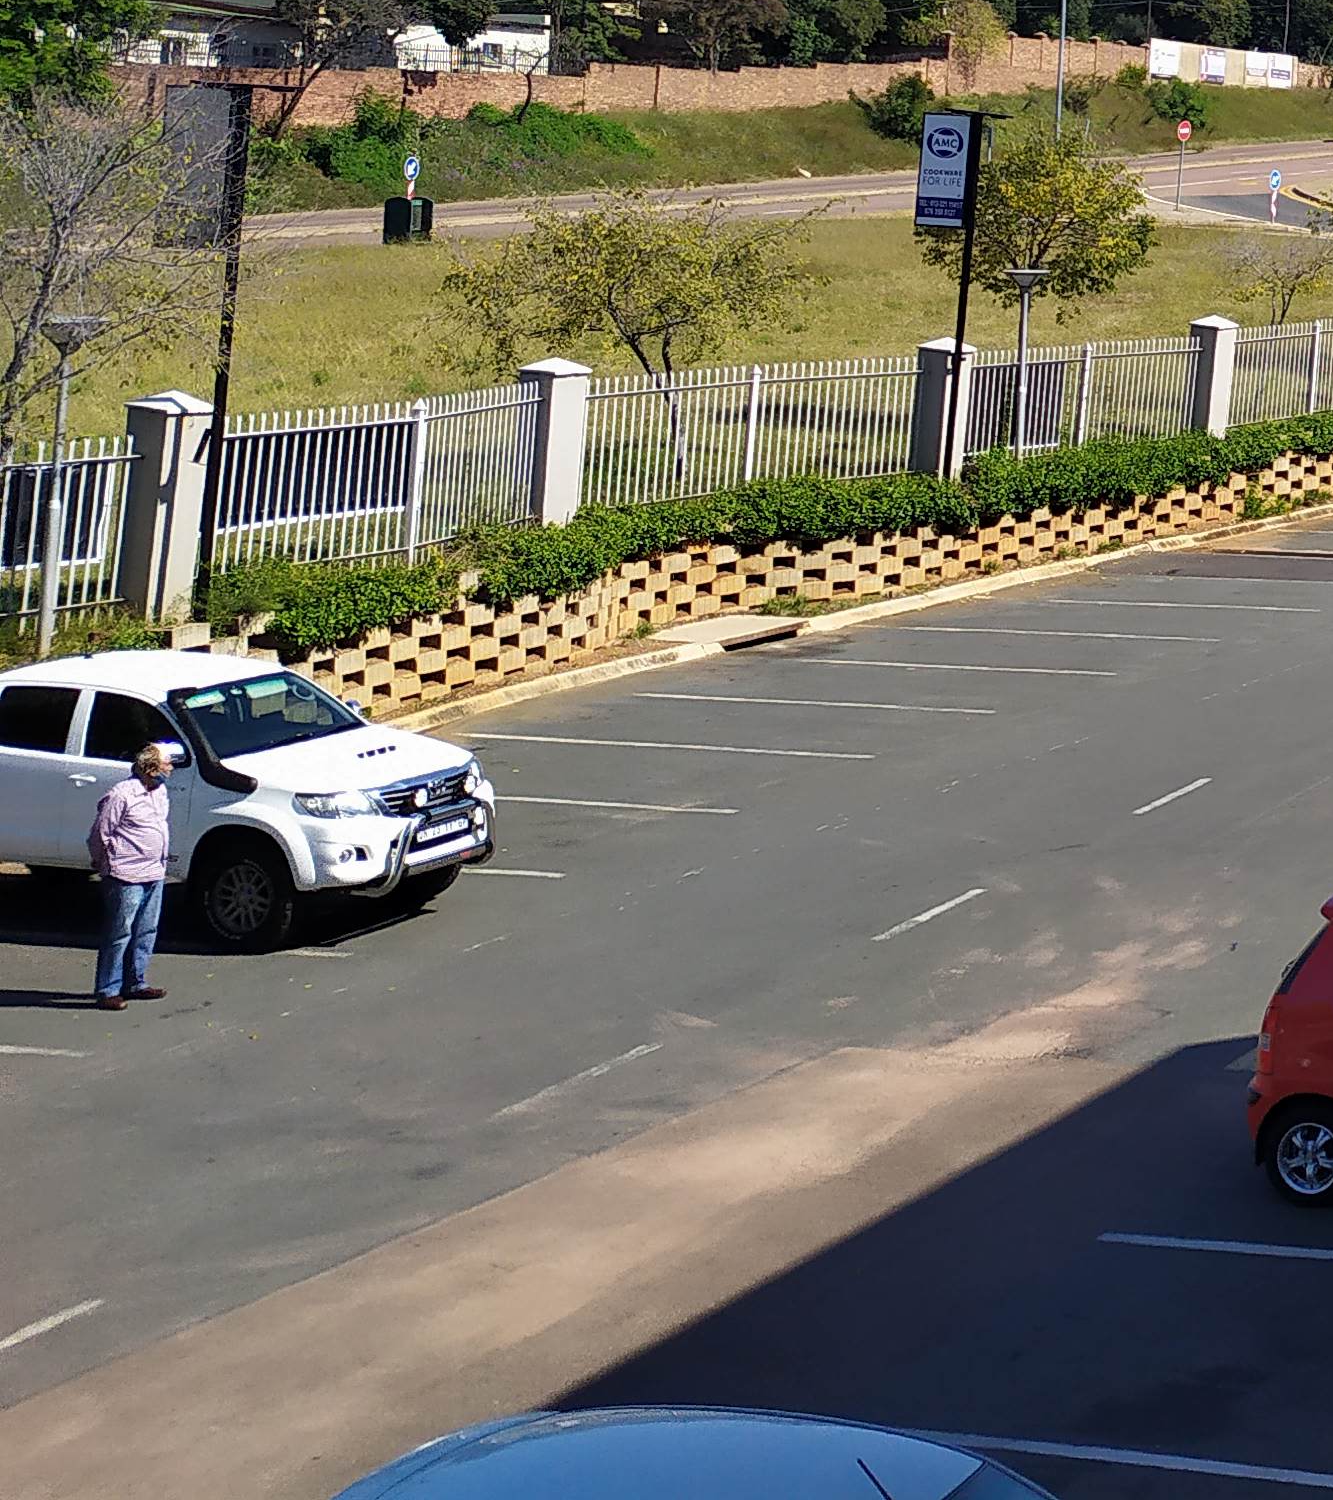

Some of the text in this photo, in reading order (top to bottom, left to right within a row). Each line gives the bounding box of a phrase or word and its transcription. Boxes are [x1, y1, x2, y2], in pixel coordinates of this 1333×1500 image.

[934, 138, 958, 149] AMC
[923, 168, 962, 176] COOKWARE
[923, 177, 962, 187] FOR LIFE
